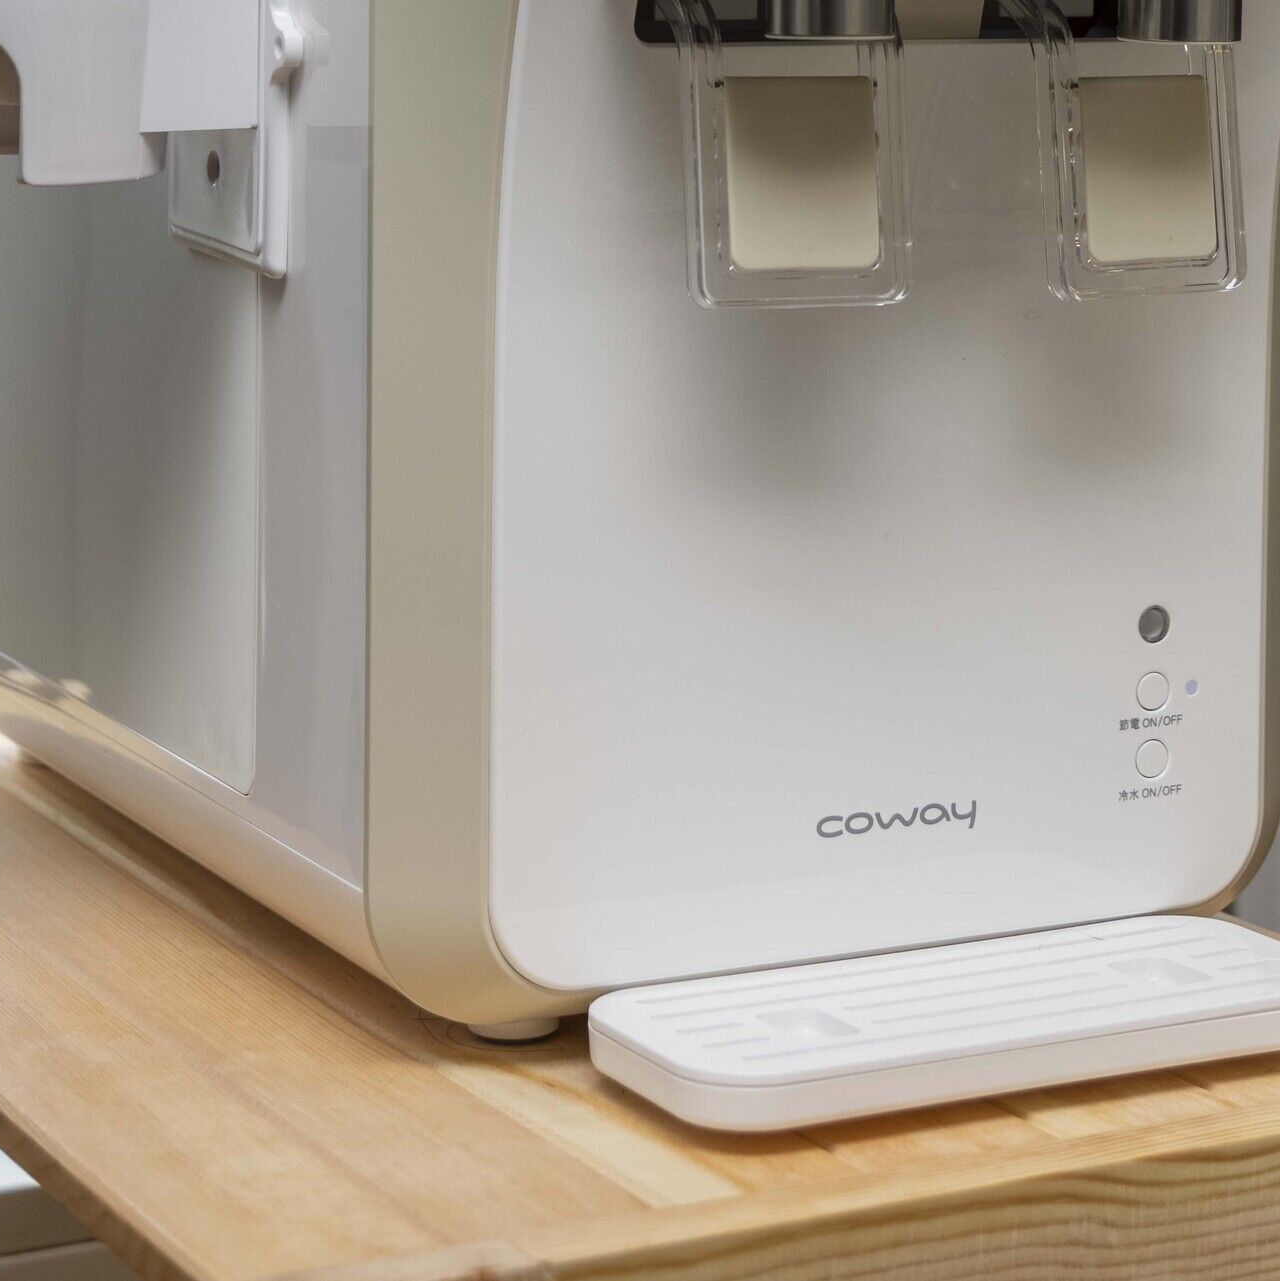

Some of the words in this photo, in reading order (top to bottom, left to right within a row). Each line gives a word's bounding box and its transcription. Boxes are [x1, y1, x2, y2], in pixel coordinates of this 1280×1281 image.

[1143, 714, 1183, 728] ON/OFF
[1119, 788, 1139, 802] 冷水
[1142, 784, 1182, 799] ON/OFF
[816, 799, 977, 839] coway
